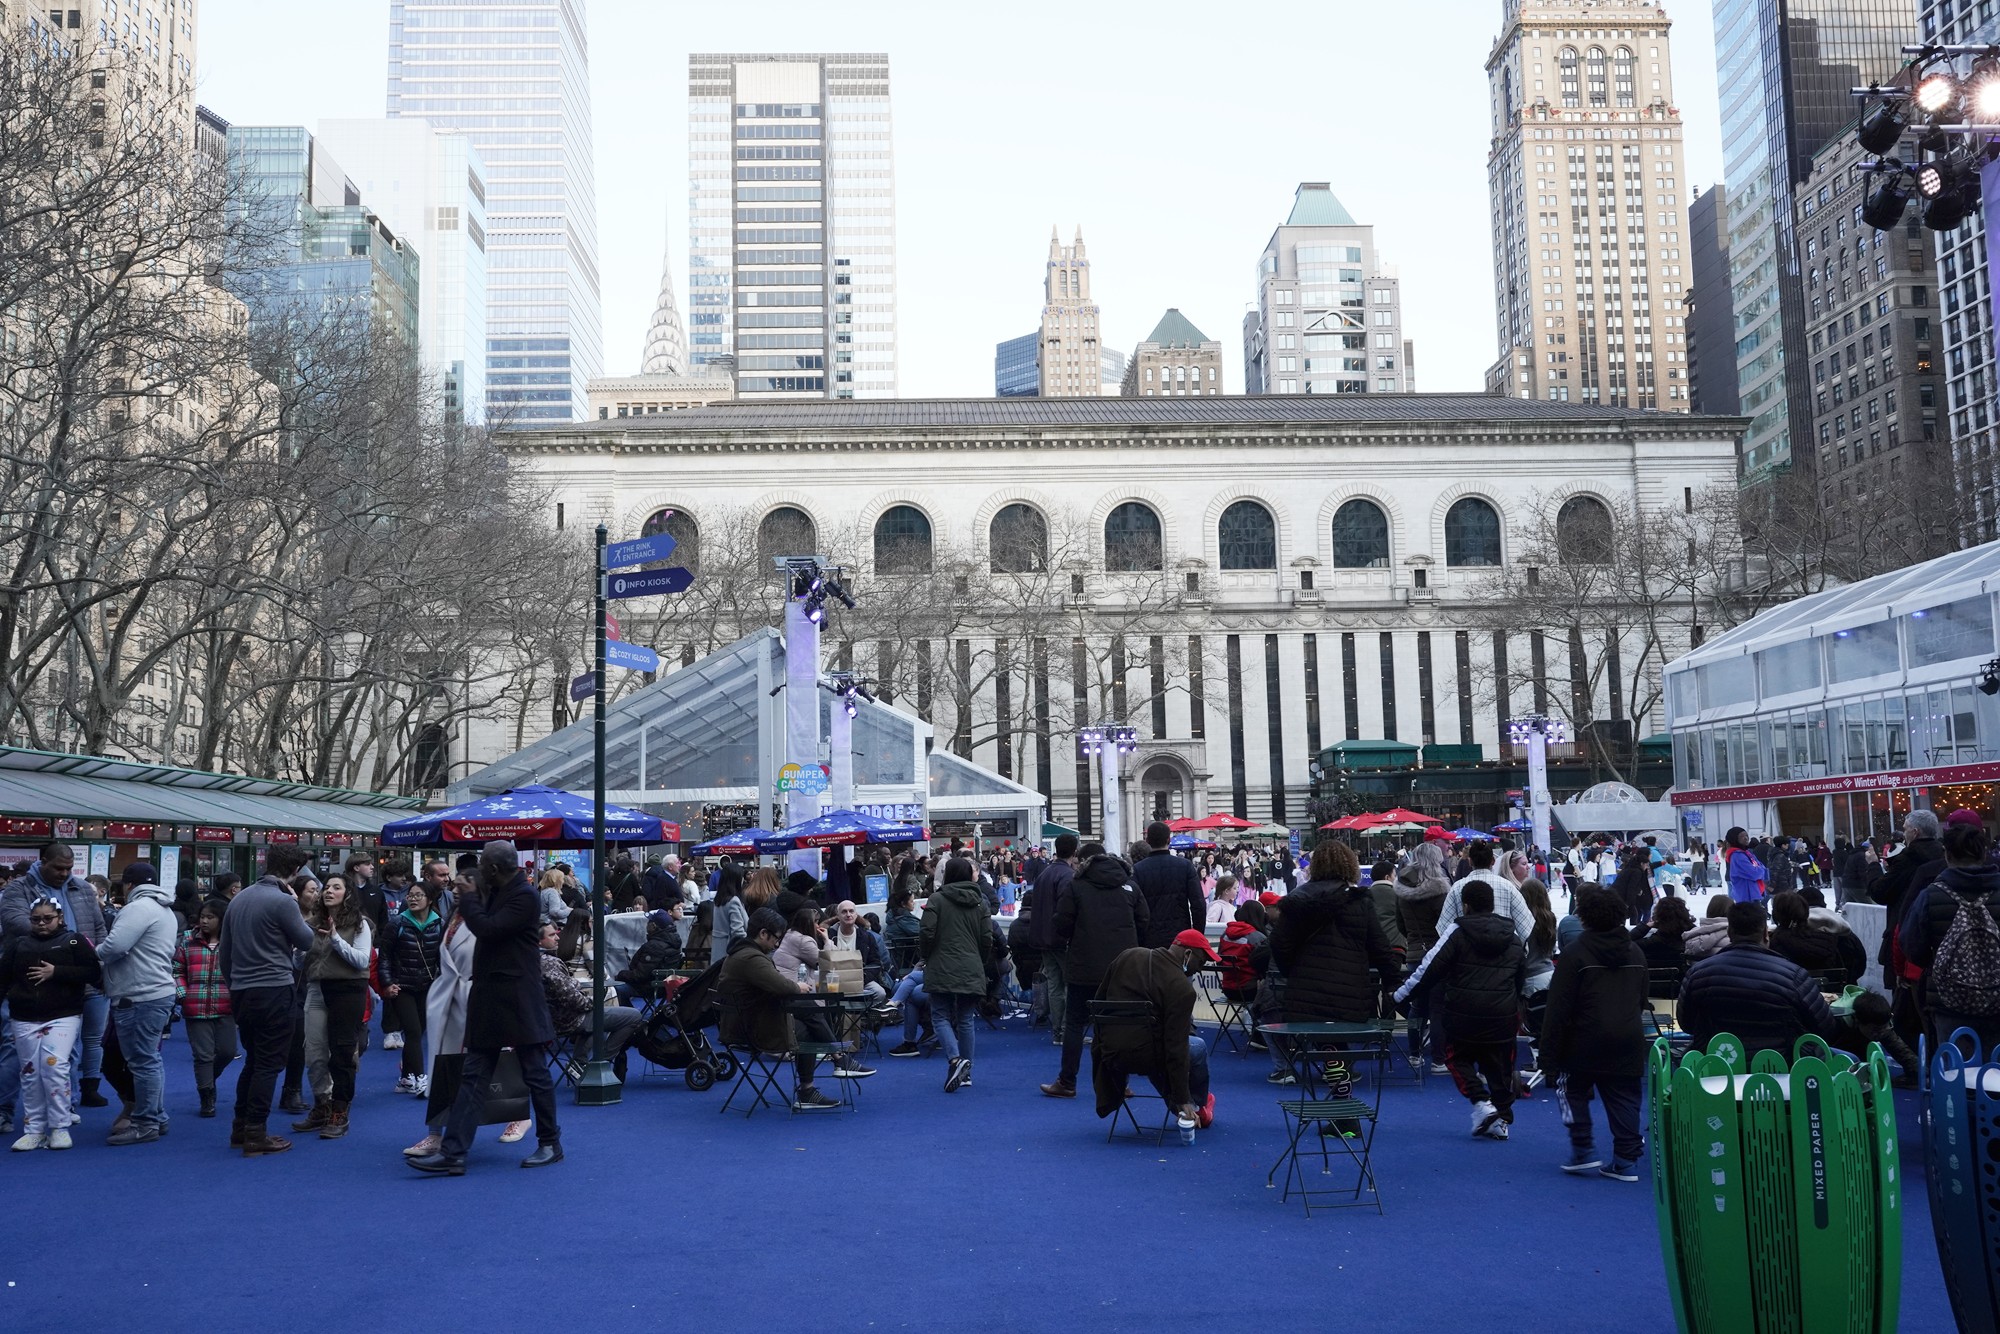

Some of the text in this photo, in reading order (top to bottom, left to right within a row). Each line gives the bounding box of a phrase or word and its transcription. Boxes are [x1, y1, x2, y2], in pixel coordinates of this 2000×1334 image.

[623, 541, 651, 553] THE RINK
[622, 549, 656, 561] ENTRANCE
[627, 577, 671, 588] INFO KIOSK
[618, 650, 650, 663] COZY IGLOOS
[784, 770, 824, 779] BUMPER
[781, 780, 806, 789] CARS
[1854, 777, 1876, 787] Winter
[1877, 775, 1900, 787] Village
[1909, 775, 1923, 785] Bryant
[1197, 975, 1218, 989] Vill
[1811, 1113, 1824, 1200] MIXED PAPER
